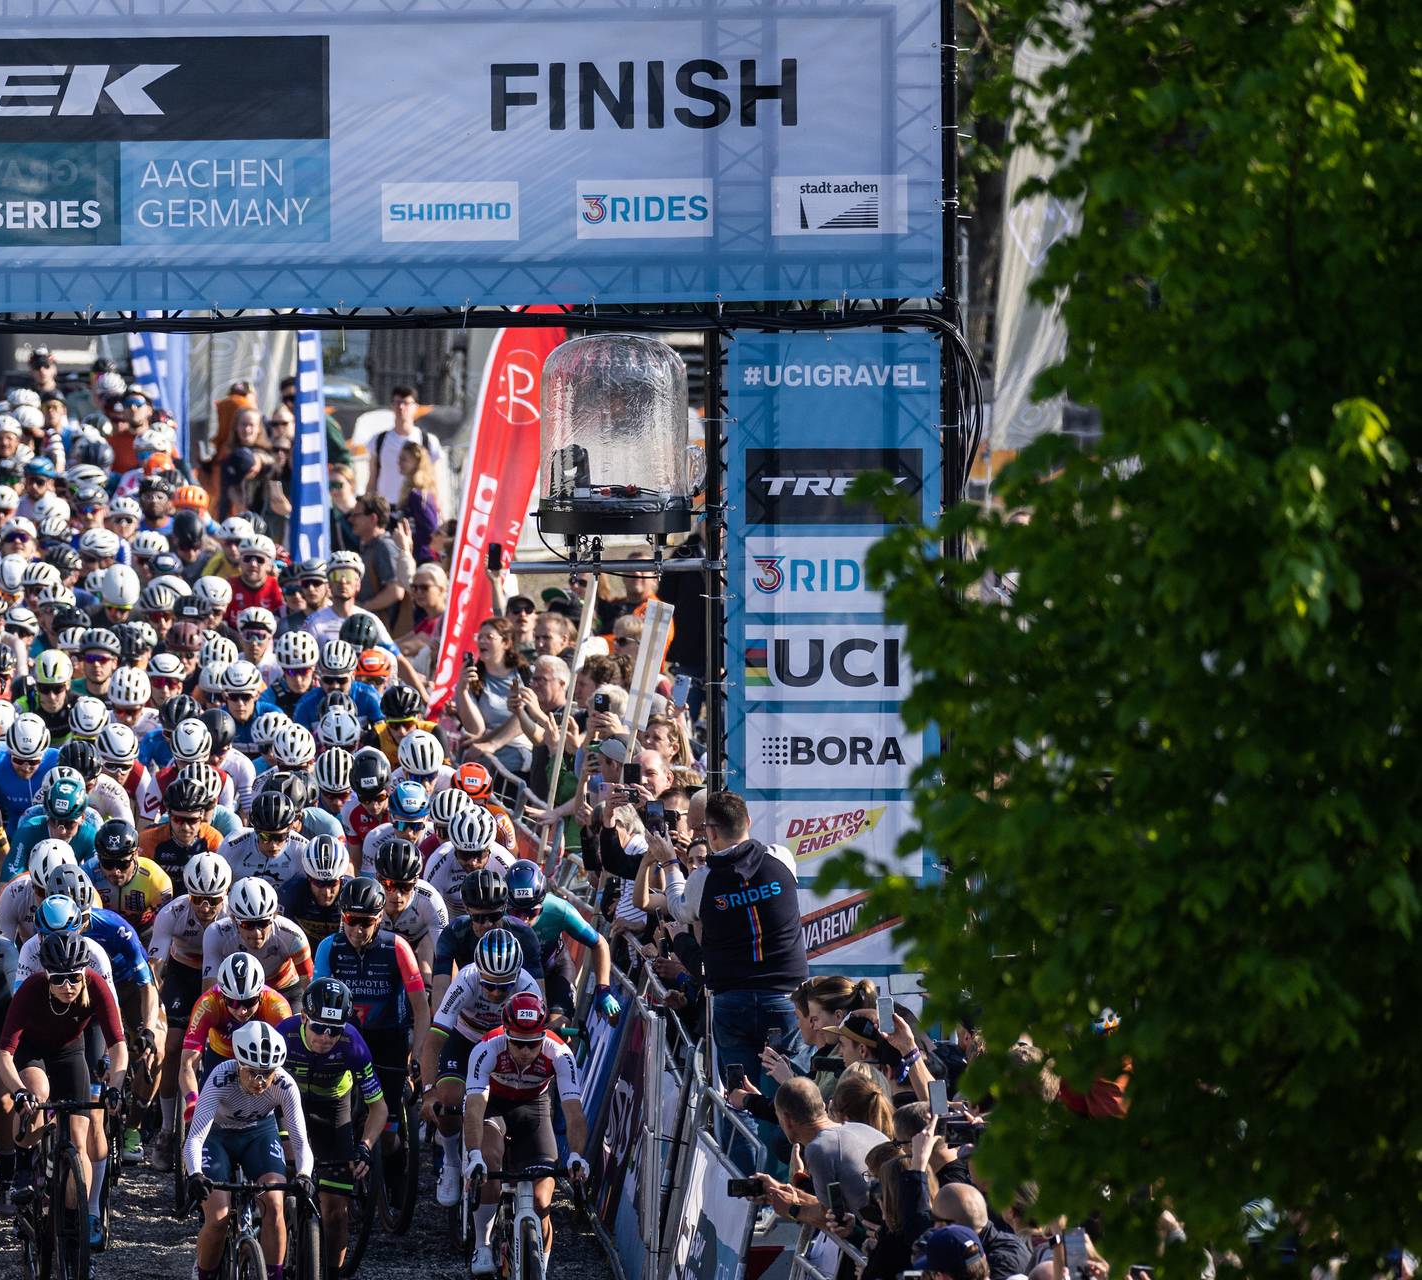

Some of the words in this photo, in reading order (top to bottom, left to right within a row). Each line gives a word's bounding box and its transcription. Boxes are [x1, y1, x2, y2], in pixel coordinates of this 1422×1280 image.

[489, 58, 798, 132] FINISH
[140, 158, 283, 188] AACHEN
[799, 181, 832, 195] stadt
[833, 181, 878, 195] aachen
[138, 198, 311, 227] GERMANY
[389, 202, 511, 222] SHIMANO
[743, 364, 927, 387] #UCIGRAVEL
[752, 555, 885, 594] 3RID
[774, 638, 899, 687] UCI
[790, 736, 906, 765] BORA
[786, 809, 865, 838] DEXTRO
[796, 820, 865, 857] ENERGY
